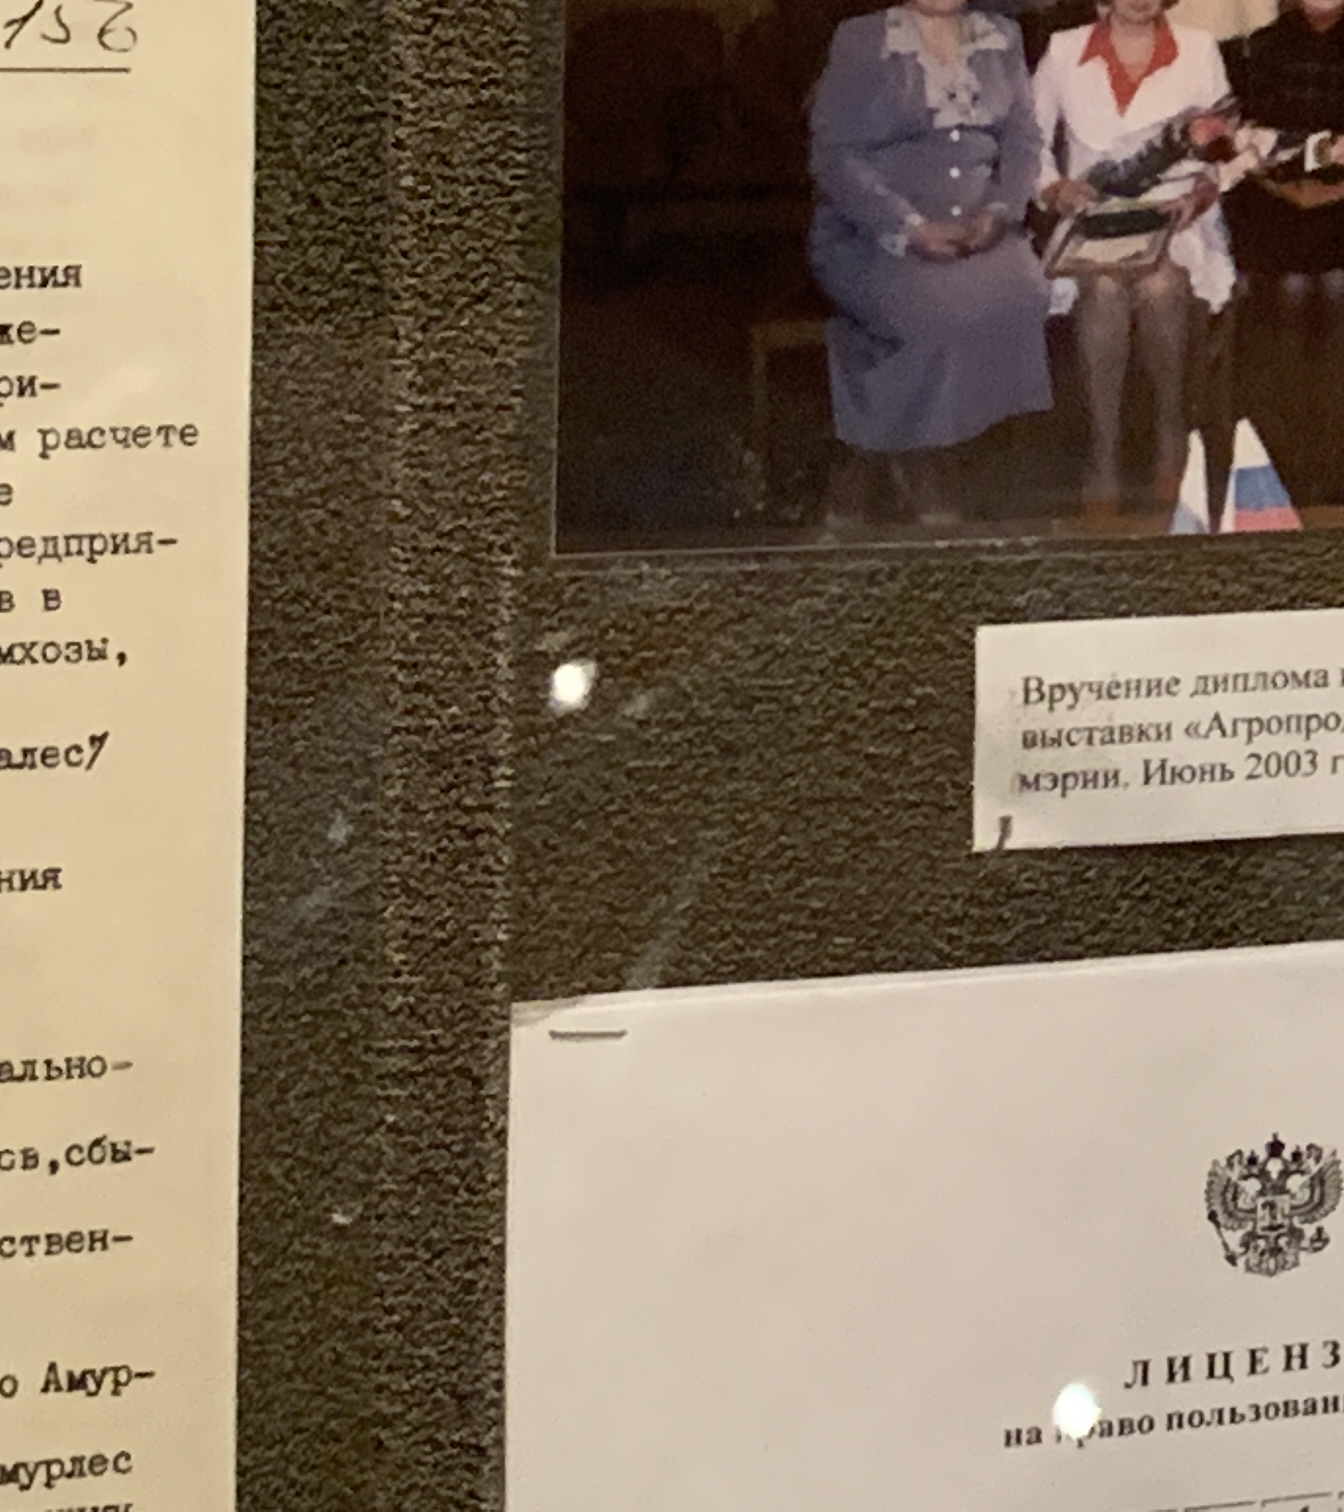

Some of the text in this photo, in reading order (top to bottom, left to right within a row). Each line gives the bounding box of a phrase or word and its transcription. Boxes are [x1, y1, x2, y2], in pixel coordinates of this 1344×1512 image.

[37, 422, 200, 460] расчете
[40, 587, 63, 613] в
[1021, 672, 1183, 711] Вручение
[1190, 664, 1330, 702] диплома
[1020, 719, 1174, 752] выставки
[1017, 764, 1131, 797] мэрии.
[1141, 755, 1236, 788] Июнь
[1244, 748, 1319, 781] 2003
[39, 1359, 157, 1398] Амур-
[1004, 1425, 1044, 1449] на
